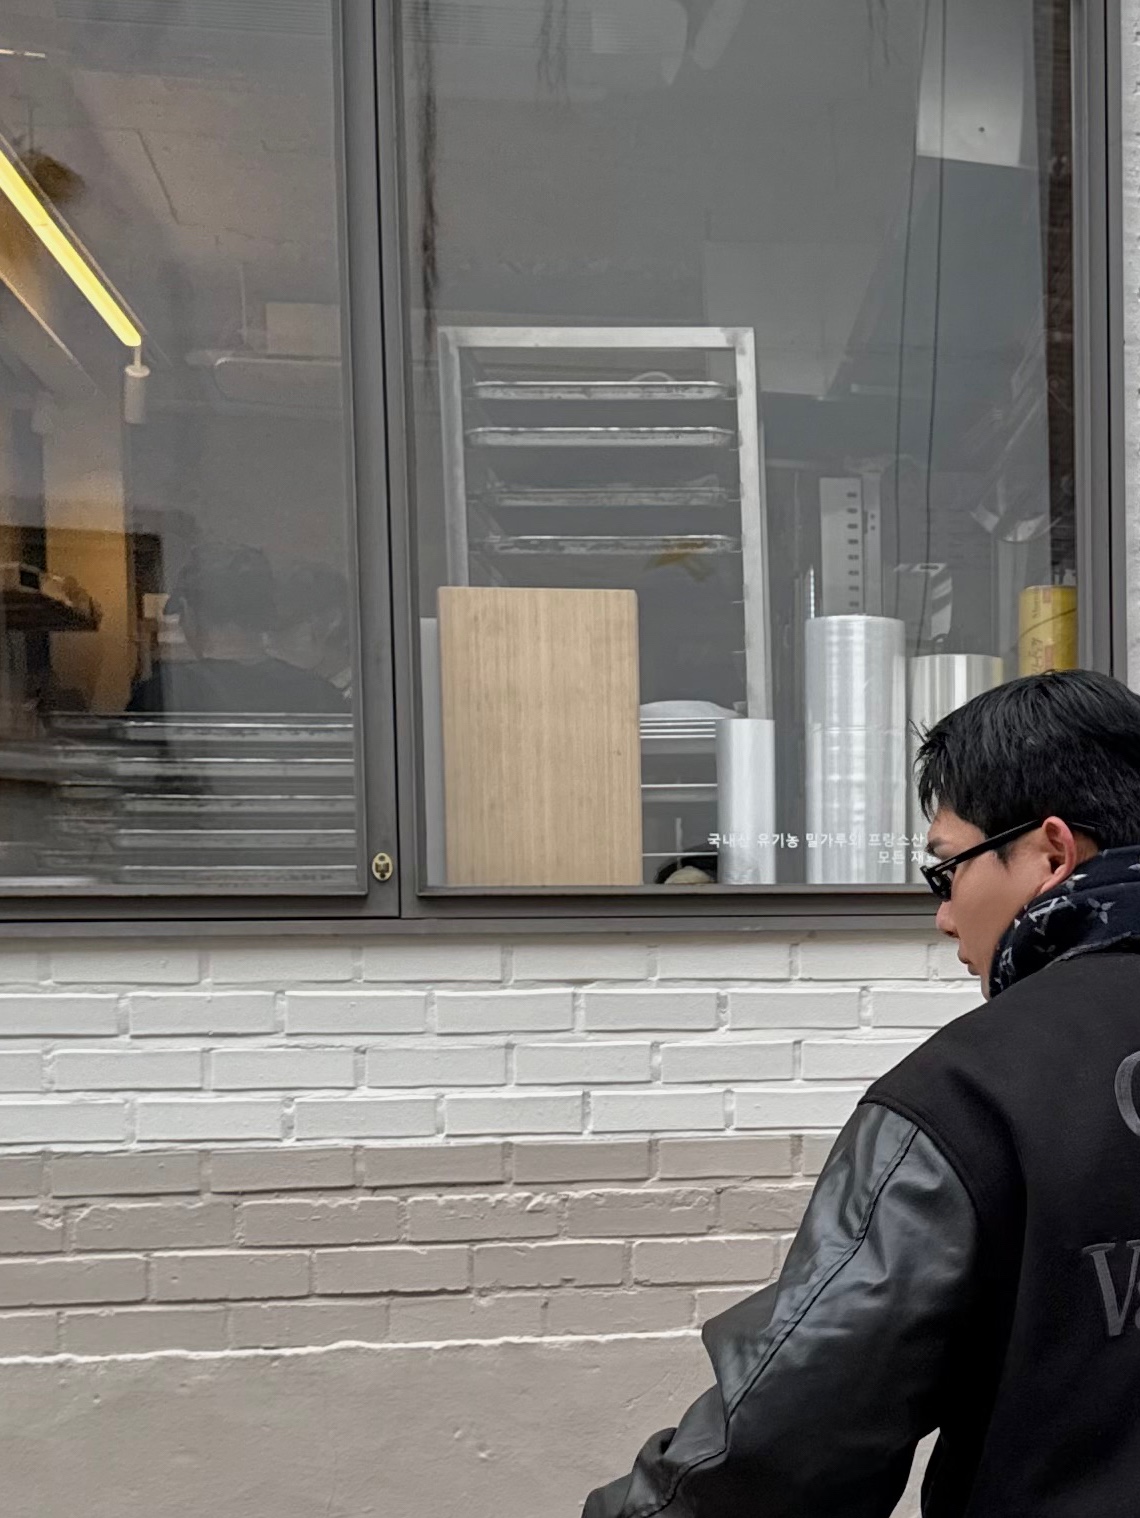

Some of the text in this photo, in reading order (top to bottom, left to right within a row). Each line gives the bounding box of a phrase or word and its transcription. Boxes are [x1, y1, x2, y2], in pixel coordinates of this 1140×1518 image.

[707, 832, 926, 849] 국내산 유기농 밀가루와 프랑스산
[878, 850, 905, 865] 모든
